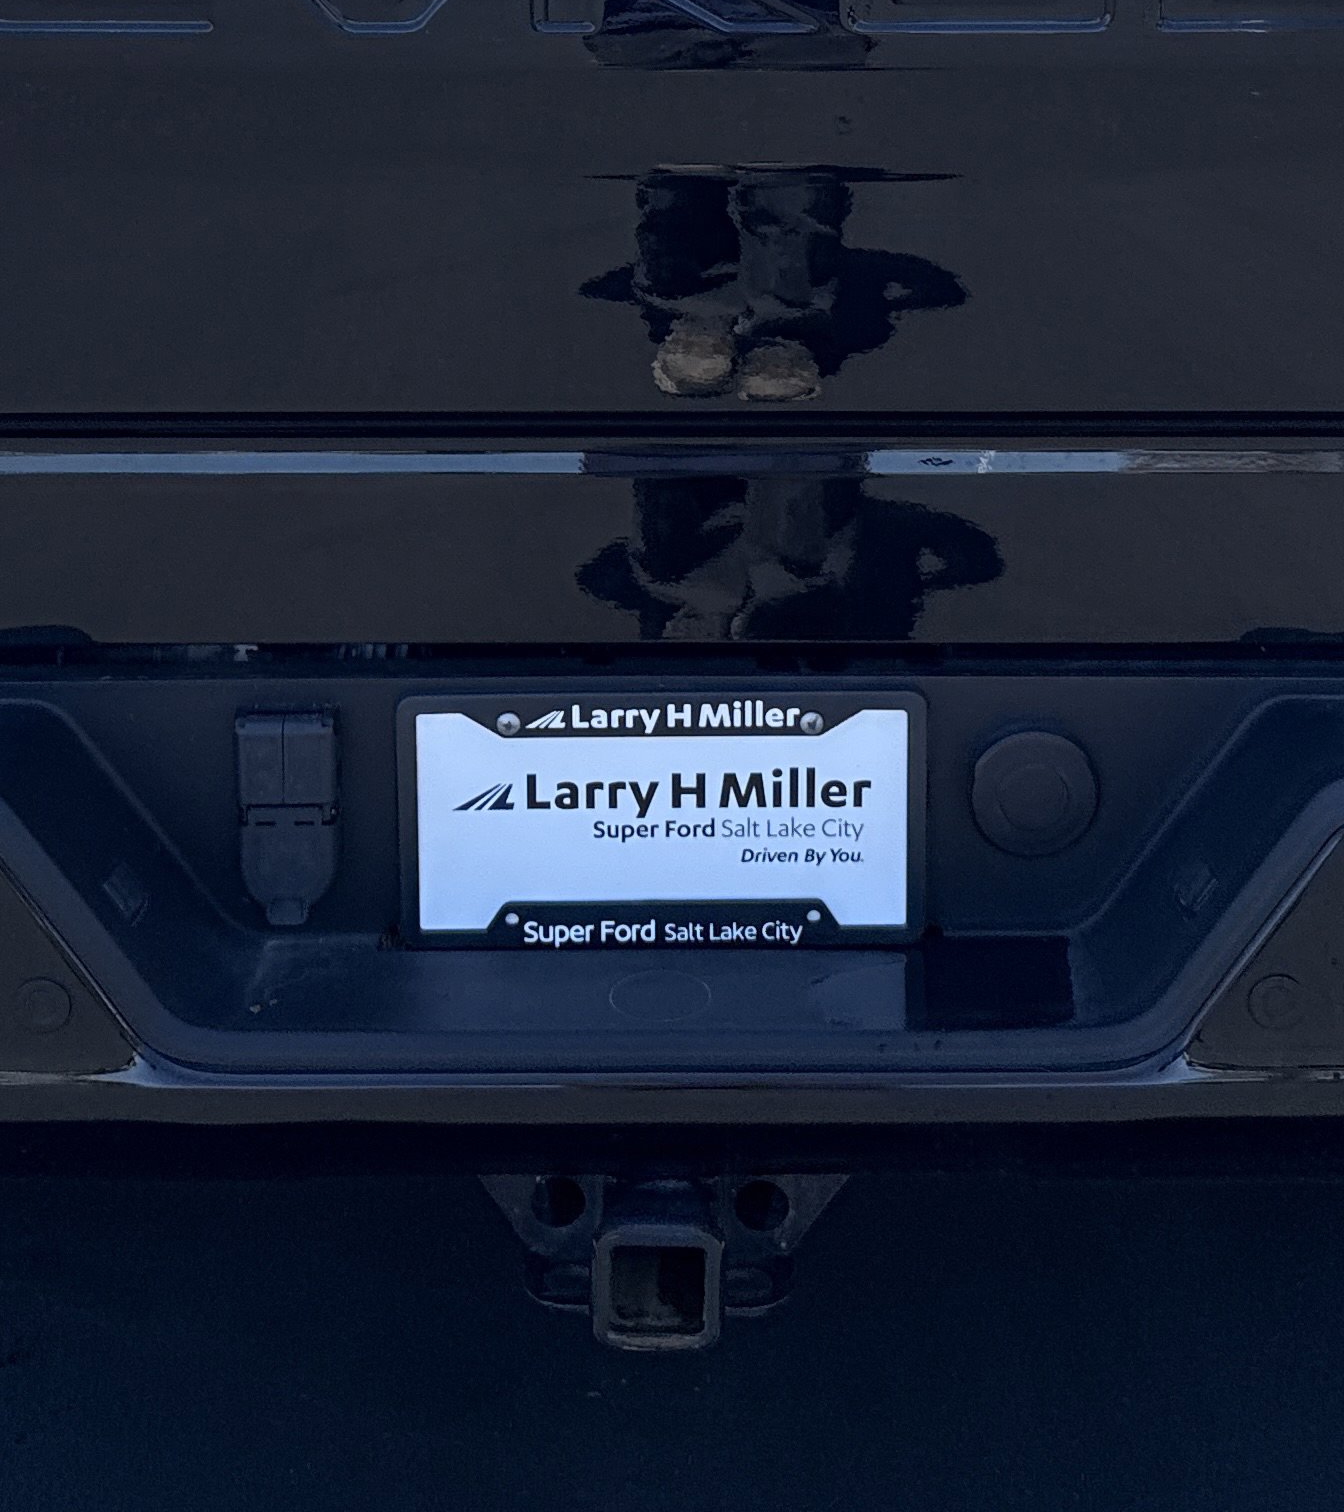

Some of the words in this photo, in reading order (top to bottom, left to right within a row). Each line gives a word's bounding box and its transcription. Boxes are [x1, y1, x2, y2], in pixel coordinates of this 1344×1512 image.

[571, 704, 661, 734] Larry
[666, 703, 692, 728] H
[698, 700, 801, 728] Miller
[526, 773, 660, 818] Larry
[670, 772, 706, 808] H
[718, 767, 872, 808] Miller
[593, 820, 657, 843] Super
[665, 818, 716, 838] Ford
[721, 818, 761, 838] Salt
[766, 816, 816, 838] Lake
[821, 816, 865, 842] City
[740, 848, 799, 864] Driven
[804, 848, 826, 866] By
[523, 920, 595, 948] Super
[600, 919, 656, 943] Ford
[664, 923, 704, 942] Salt
[709, 922, 757, 942] Lake
[762, 921, 804, 945] City
